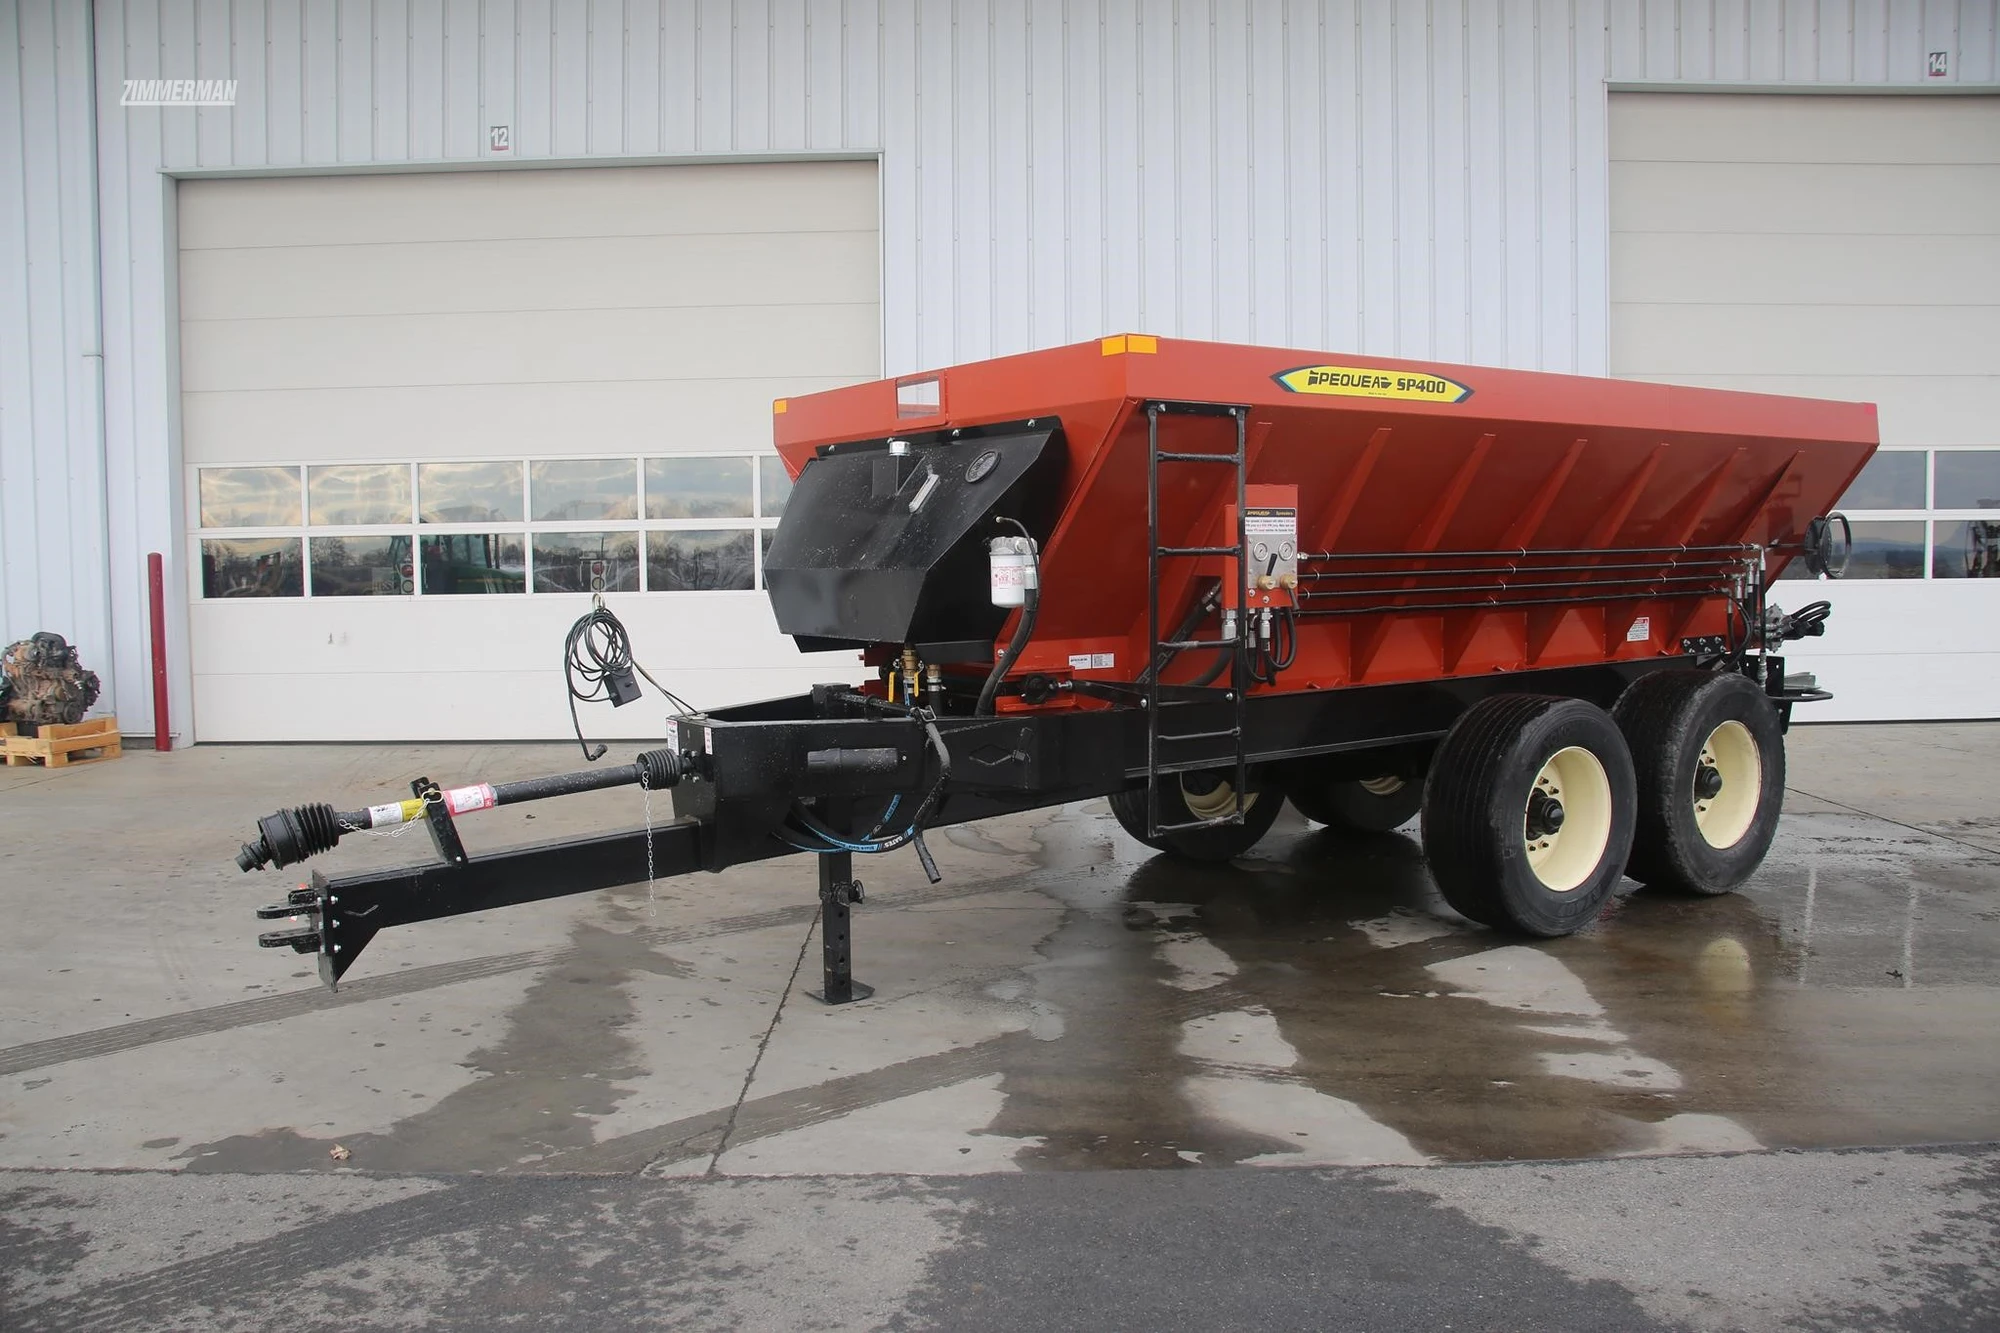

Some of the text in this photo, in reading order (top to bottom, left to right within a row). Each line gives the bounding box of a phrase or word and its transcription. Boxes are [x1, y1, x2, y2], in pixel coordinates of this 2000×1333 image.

[1929, 53, 1947, 73] 14
[491, 127, 508, 147] 12
[1396, 378, 1446, 394] SP400
